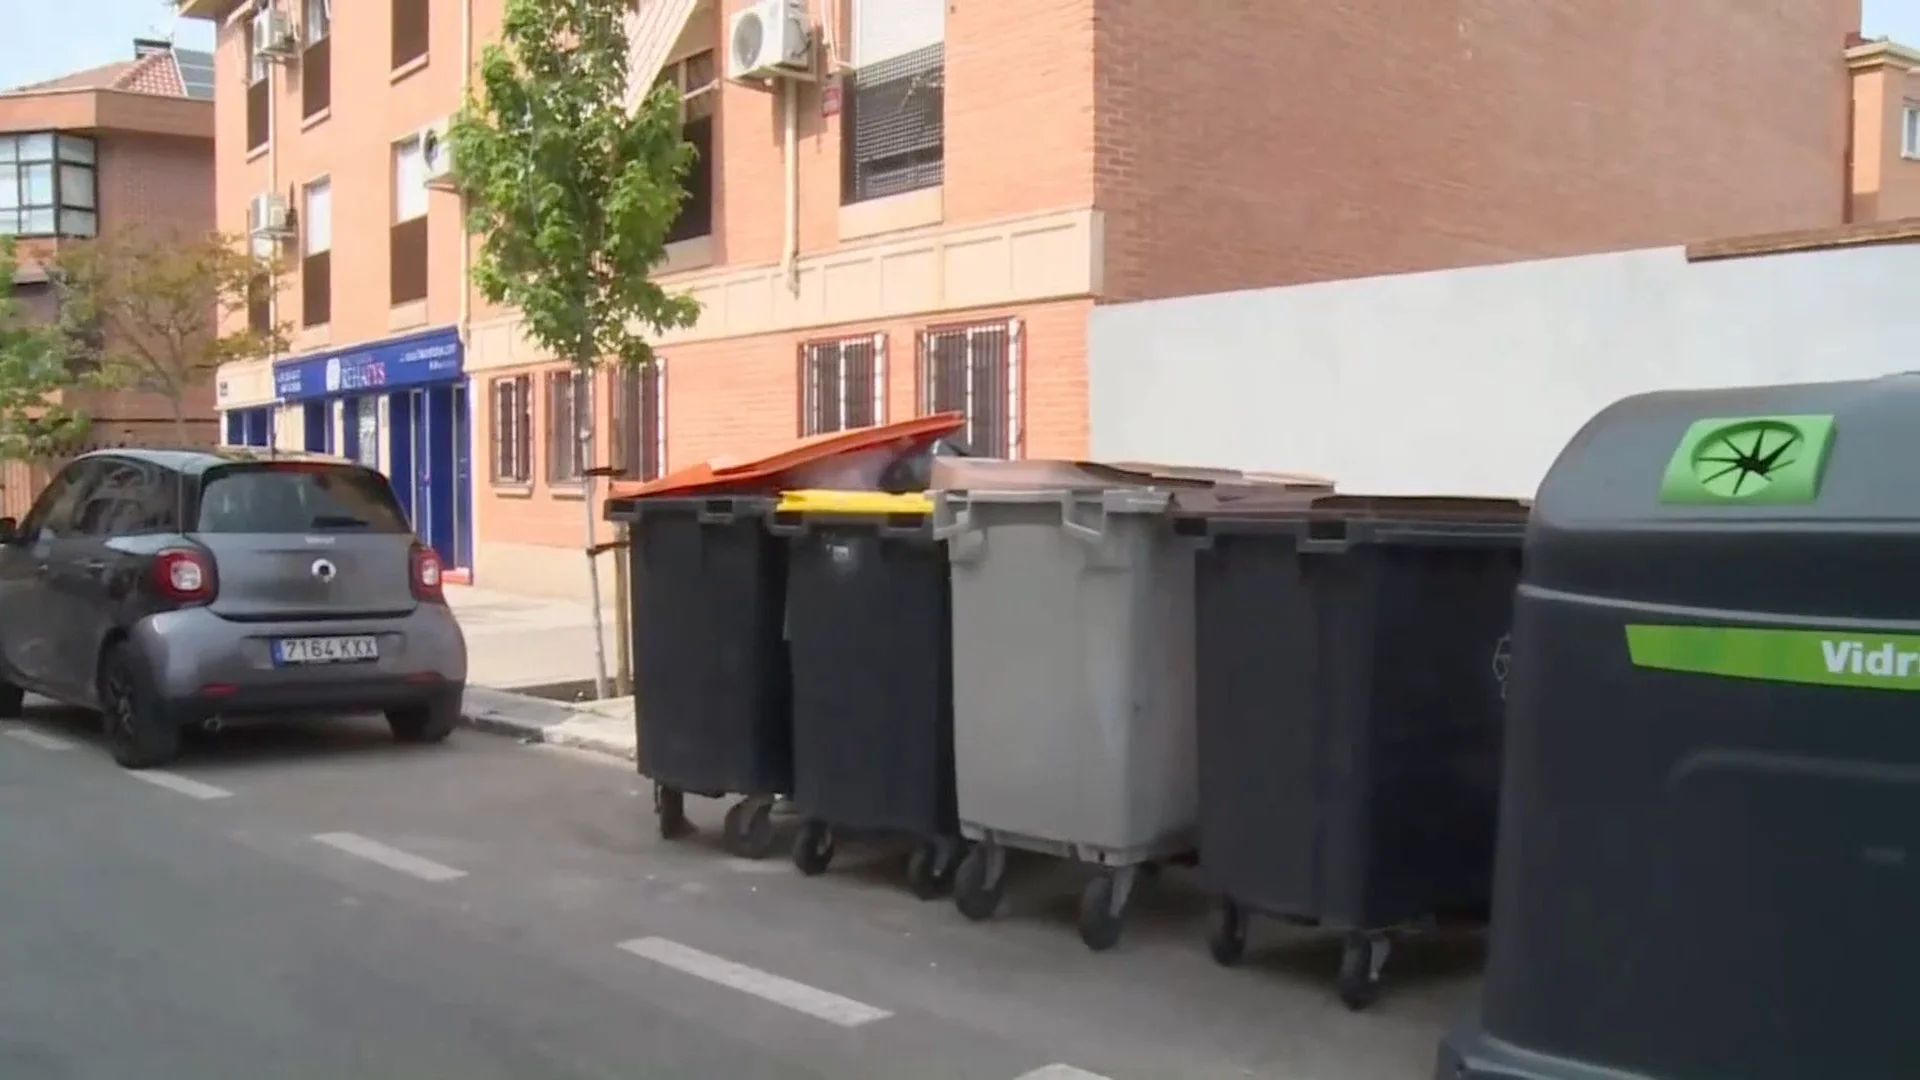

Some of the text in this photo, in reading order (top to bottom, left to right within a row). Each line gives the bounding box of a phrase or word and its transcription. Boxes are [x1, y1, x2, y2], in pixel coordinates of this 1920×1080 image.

[286, 639, 373, 658] 7164 KXX
[1821, 640, 1920, 677] Vidr
